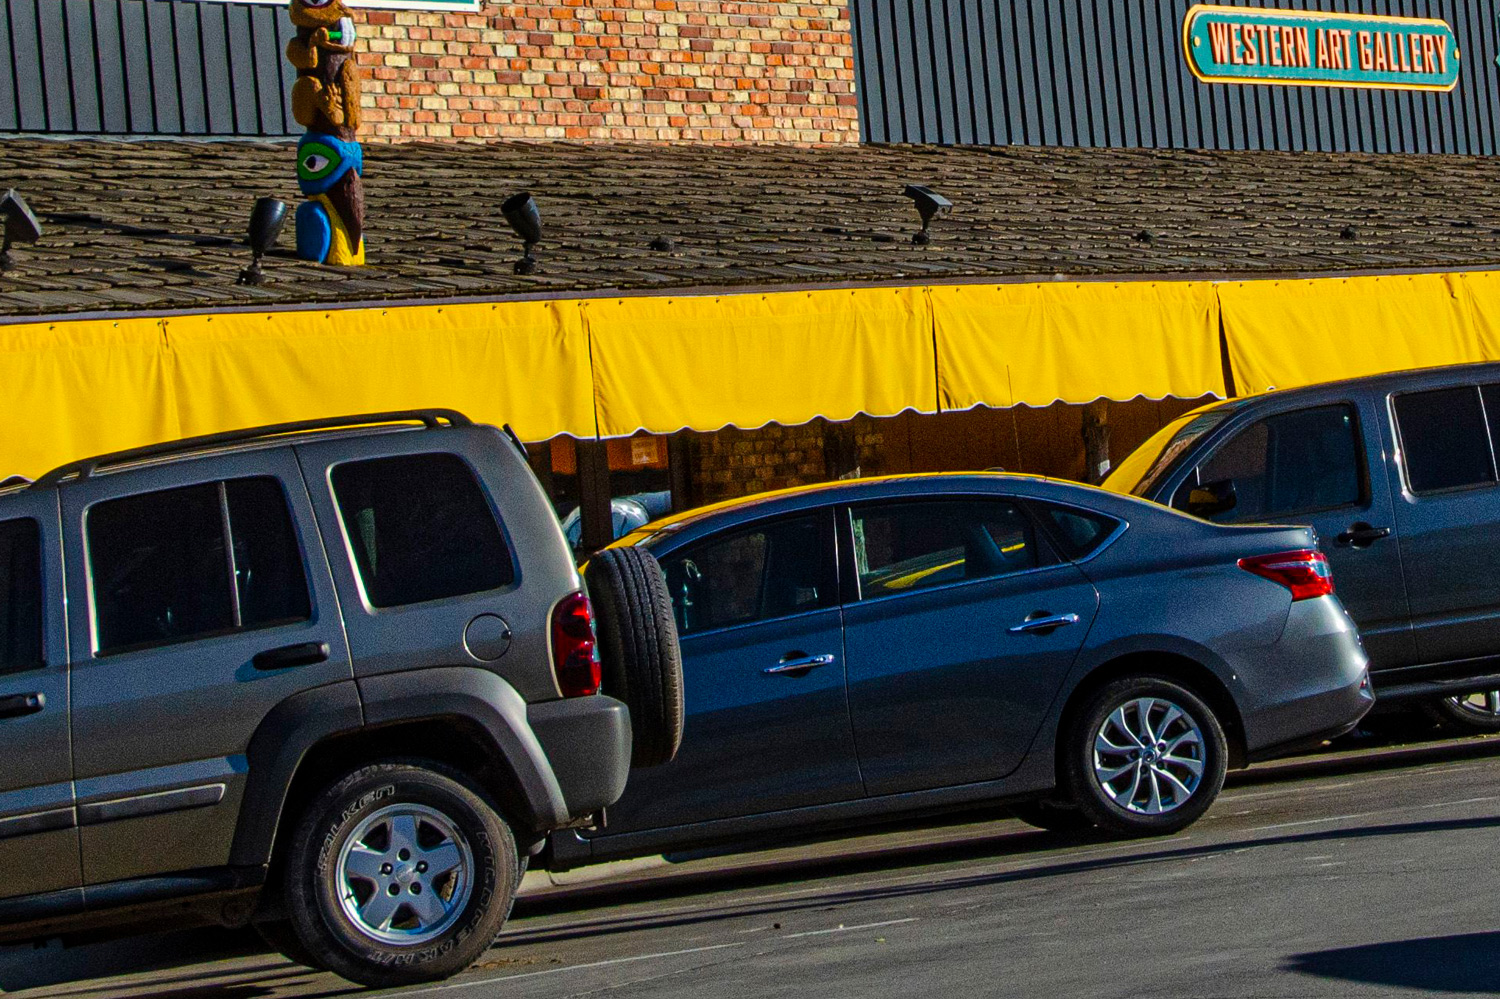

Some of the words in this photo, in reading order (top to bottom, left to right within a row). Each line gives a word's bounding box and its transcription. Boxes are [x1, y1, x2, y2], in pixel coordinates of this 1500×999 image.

[1208, 22, 1311, 68] WESTERN
[1316, 28, 1351, 70] ART
[1358, 31, 1447, 74] GALLERY
